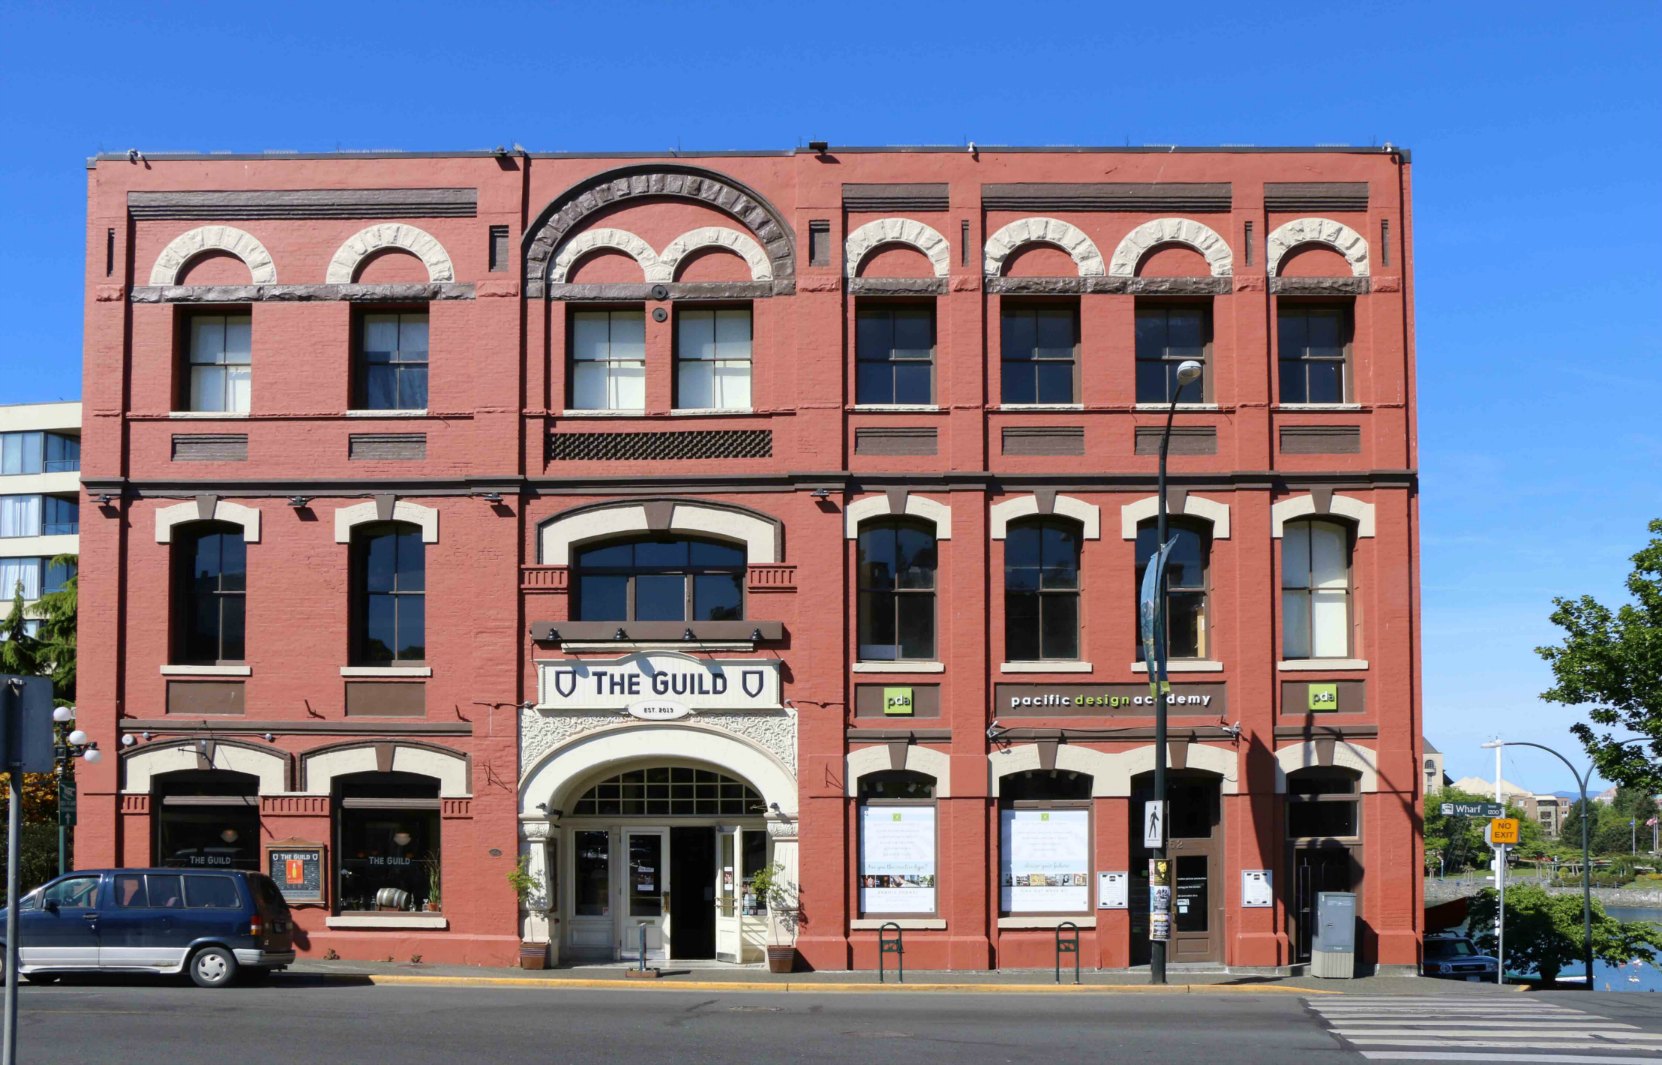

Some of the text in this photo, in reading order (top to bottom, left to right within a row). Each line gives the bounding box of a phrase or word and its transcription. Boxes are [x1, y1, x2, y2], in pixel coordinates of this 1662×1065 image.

[592, 671, 727, 695] THE GUILD
[888, 691, 911, 709] pda
[1011, 694, 1211, 709] pacific design acdemy
[1312, 690, 1334, 706] pda
[1456, 805, 1482, 813] Wharf
[190, 856, 231, 864] THE GUILD
[369, 856, 410, 864] THE GUILD
